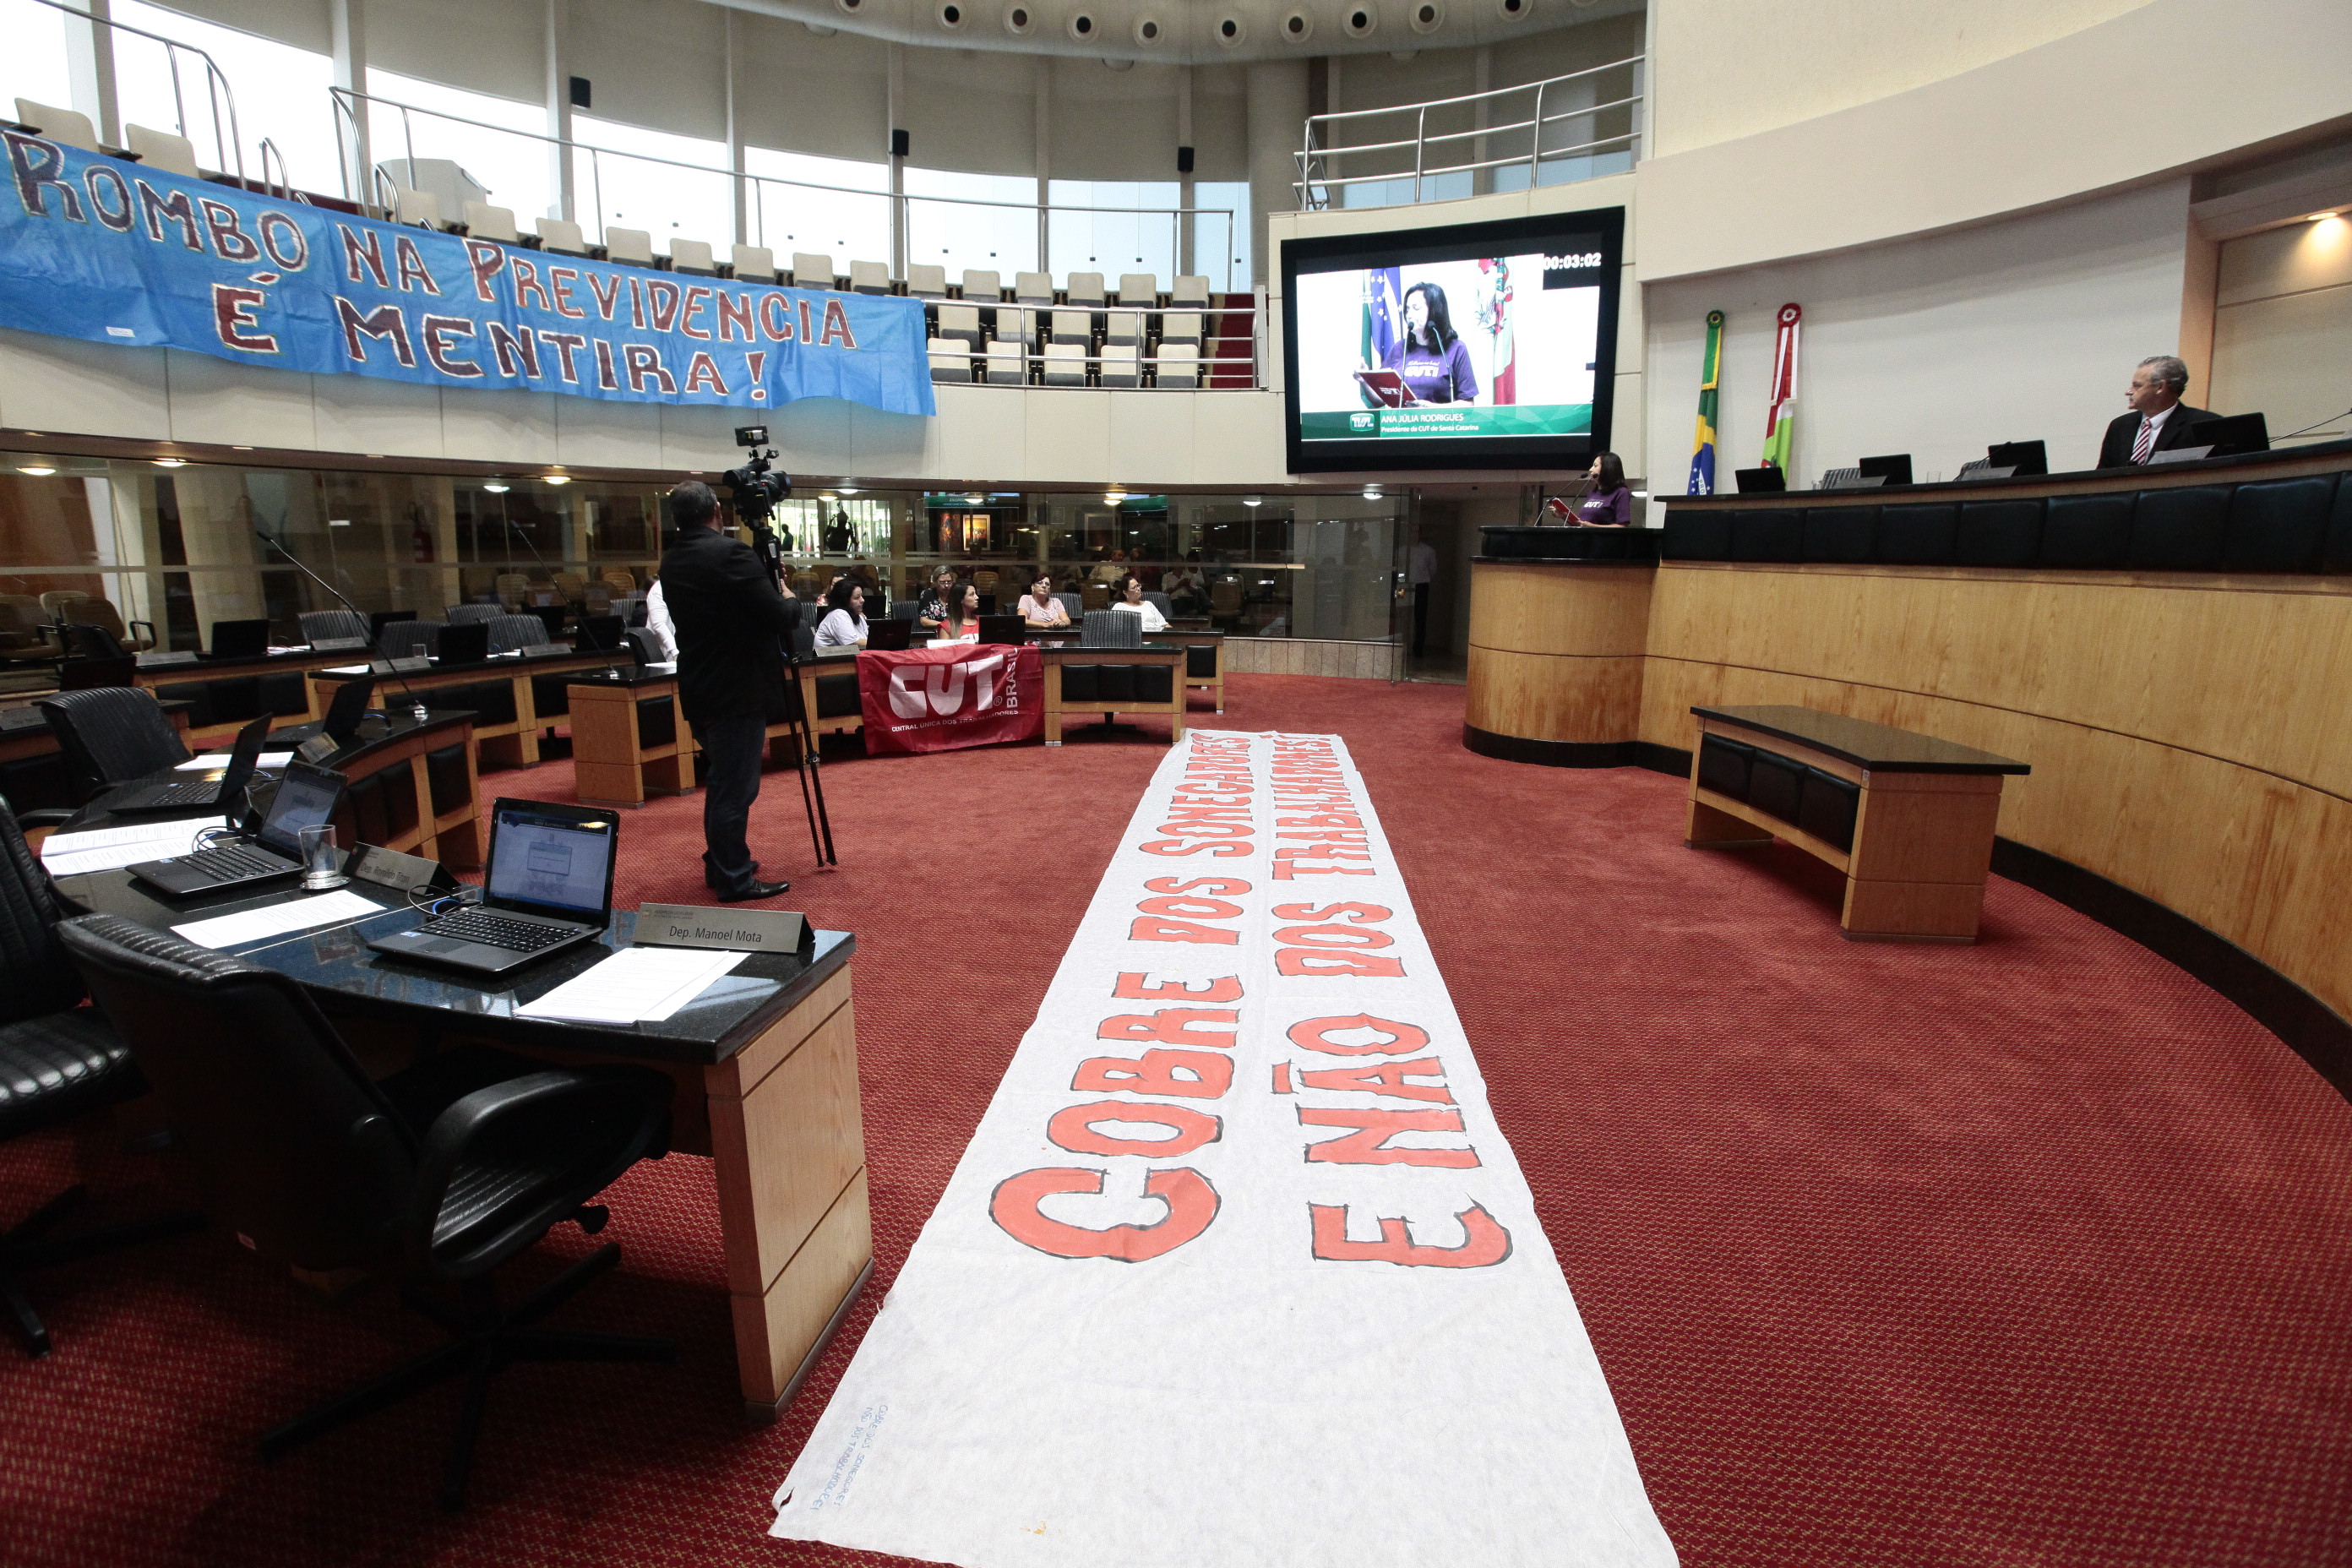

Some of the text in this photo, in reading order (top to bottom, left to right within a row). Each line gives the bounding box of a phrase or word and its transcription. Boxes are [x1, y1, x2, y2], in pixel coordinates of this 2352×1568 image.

[2, 129, 858, 349] ROMBO NA PREVIDENCIA
[1544, 252, 1602, 270] 00:03:02
[212, 271, 281, 354] É
[1381, 412, 1465, 423] ANA JÚLIA RODRIGUES
[888, 654, 1004, 719] CUT
[1006, 646, 1019, 709] BRASIL
[891, 724, 918, 732] CENTRAL
[919, 720, 941, 728] ÚNICA
[669, 925, 762, 943] Dep. Manoel Mota
[1271, 901, 1408, 977] DOS
[988, 732, 1255, 1263] COBRE DOS SONEGADORES
[1271, 1012, 1484, 1169] NÃO
[1308, 1192, 1512, 1270] E
